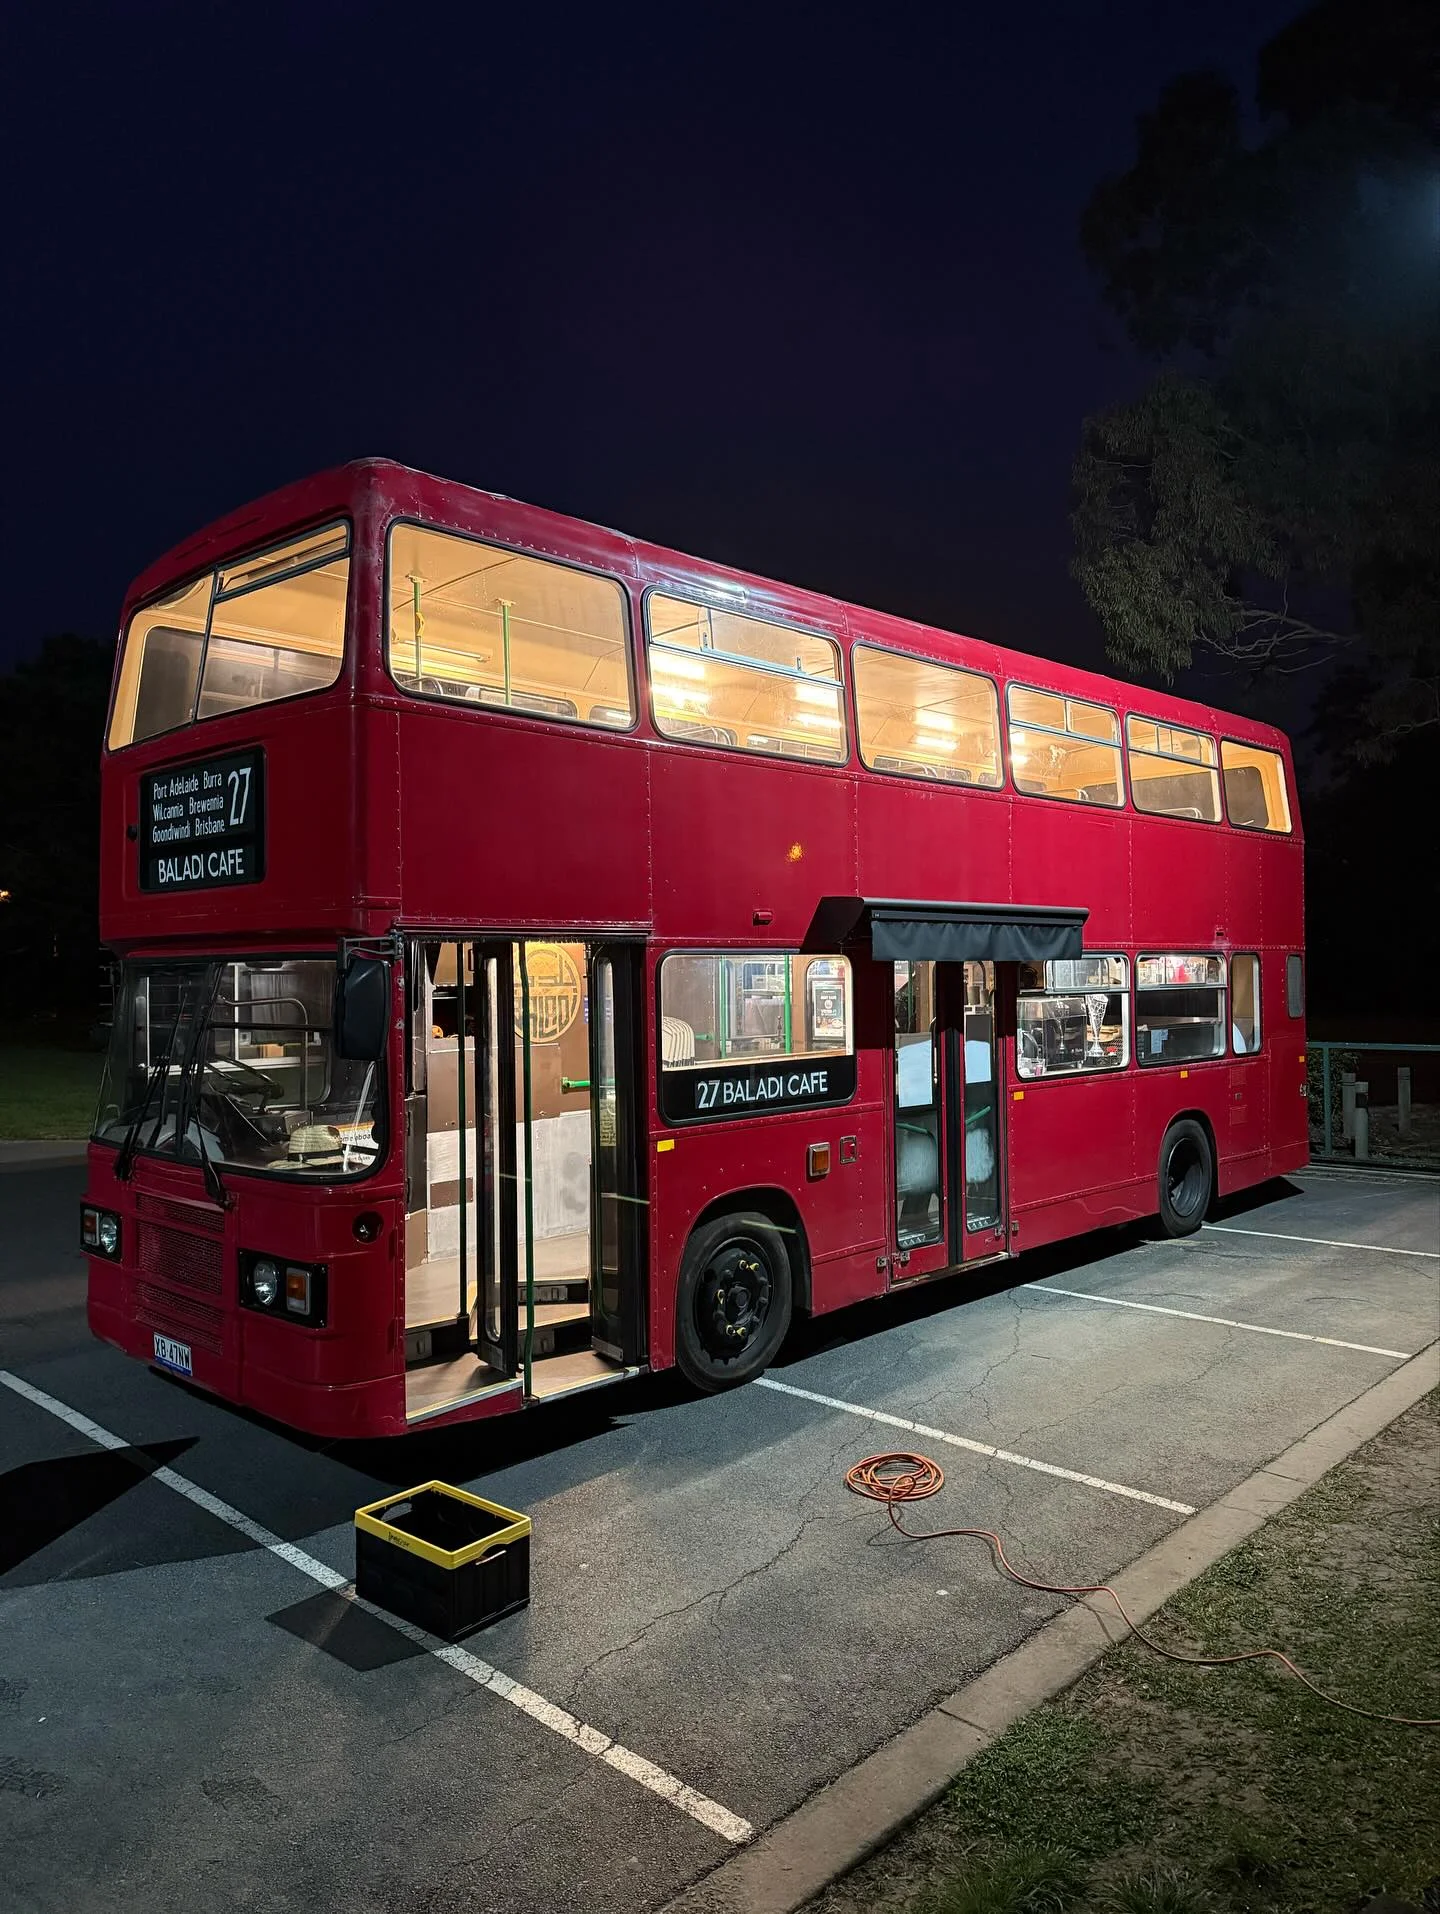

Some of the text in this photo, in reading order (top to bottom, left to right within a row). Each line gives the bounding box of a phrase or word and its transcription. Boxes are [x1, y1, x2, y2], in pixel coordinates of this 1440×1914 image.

[153, 770, 222, 801] Port Adelaide Burra
[227, 767, 252, 826] 27
[195, 815, 226, 837] Brisbane
[158, 848, 245, 884] BALADI CAFE
[697, 1070, 828, 1109] 27 BALADI CAFE
